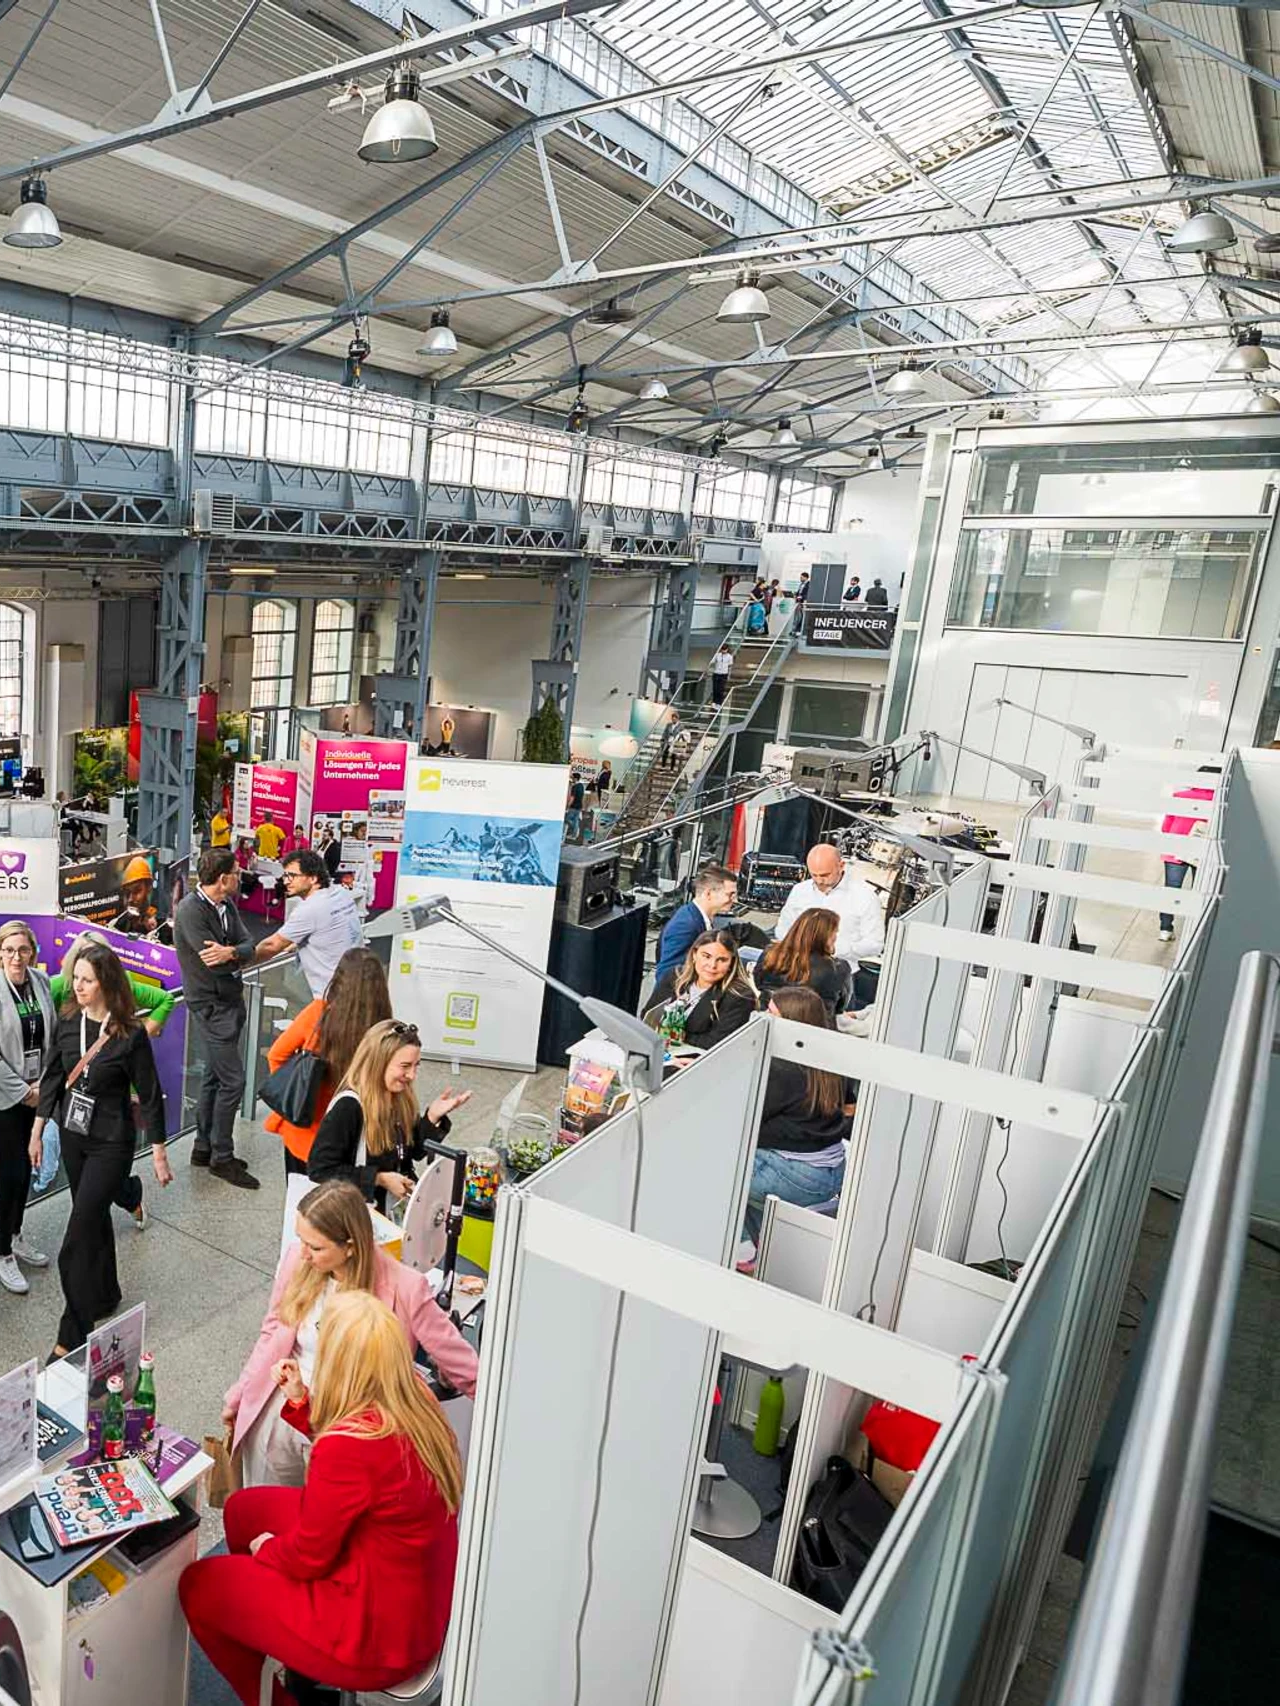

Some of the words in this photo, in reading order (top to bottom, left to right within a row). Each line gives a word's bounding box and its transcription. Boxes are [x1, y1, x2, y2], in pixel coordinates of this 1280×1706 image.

[814, 617, 888, 630] INFLUENCER
[814, 630, 841, 639] STAGE
[324, 750, 372, 760] Individuelle
[323, 760, 364, 771] Lösungen
[364, 761, 377, 771] für
[377, 761, 401, 772] jedes
[323, 771, 380, 781] Unternehmen
[253, 781, 271, 792] Erfolg
[442, 776, 487, 788] neverest
[252, 791, 291, 803] maximieren
